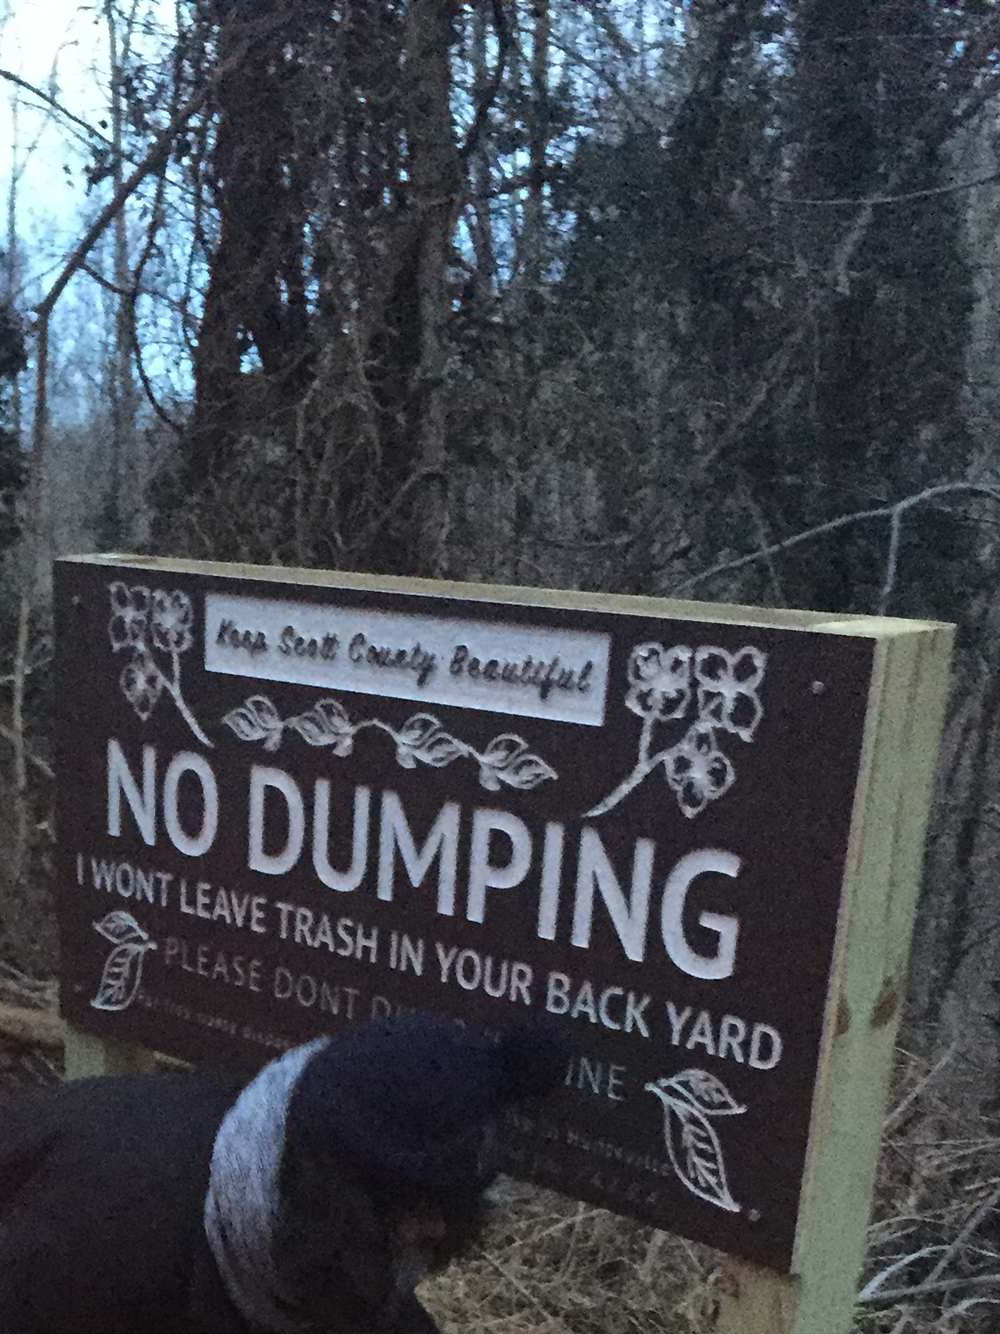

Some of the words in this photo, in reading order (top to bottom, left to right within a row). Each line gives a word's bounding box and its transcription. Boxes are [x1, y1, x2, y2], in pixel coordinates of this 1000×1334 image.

[216, 618, 268, 658] Keep
[278, 625, 340, 661] Scott
[348, 632, 437, 688] County
[449, 644, 593, 701] Beautiful
[107, 738, 219, 857] NO
[249, 763, 742, 980] DUMPING
[76, 852, 84, 885] I
[91, 857, 173, 907] WONT
[180, 877, 267, 934] LEAVE
[276, 901, 378, 963] TRASH
[389, 930, 425, 976] IN
[435, 941, 533, 1006] YOUR
[546, 971, 650, 1038] BACK
[665, 1001, 784, 1070] YARD
[164, 936, 261, 992] PLEASE
[274, 965, 360, 1019] DONT
[564, 1052, 627, 1101] INE
